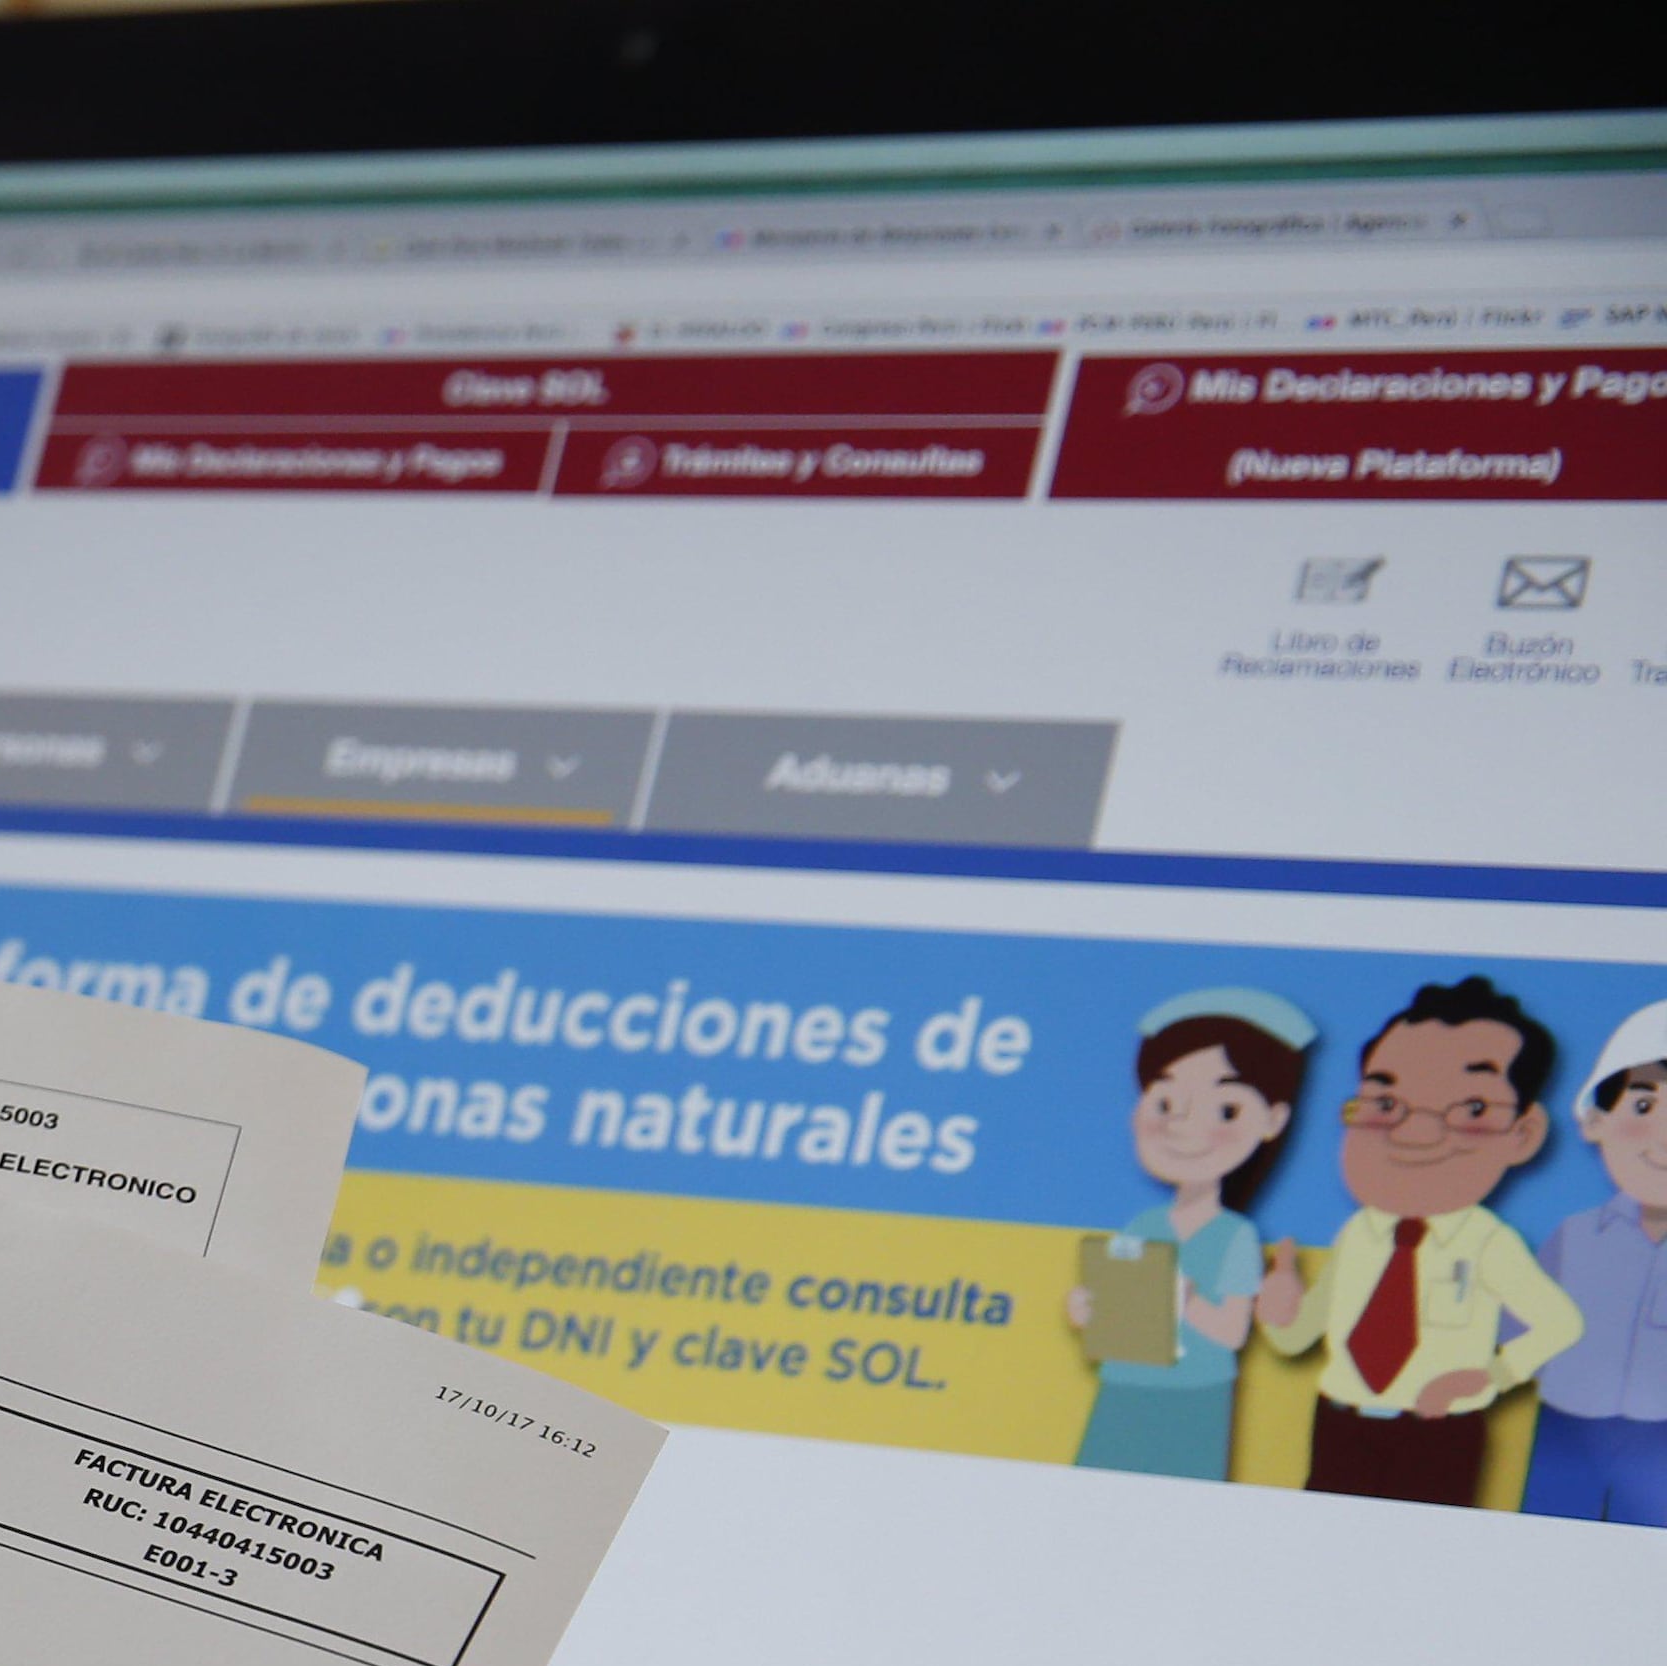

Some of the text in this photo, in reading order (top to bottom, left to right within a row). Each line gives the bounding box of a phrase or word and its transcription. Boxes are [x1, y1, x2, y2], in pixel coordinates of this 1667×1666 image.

[1187, 367, 1566, 405] Mis Declaraciones y
[1225, 449, 1562, 486] (Nueva Plataforma)
[1447, 659, 1601, 685] Electrónico
[1483, 630, 1575, 657] Buzón
[767, 753, 953, 798] Aduanas
[231, 956, 1033, 1076] de deducciones de
[571, 1086, 978, 1174] naturales
[367, 1231, 1013, 1328] o independiente consulta
[518, 1311, 615, 1358] DNI
[625, 1331, 659, 1371] y
[673, 1326, 807, 1376] clave
[823, 1340, 947, 1390] SOL.
[435, 1385, 597, 1459] 17/10/17 16:12
[73, 1449, 386, 1561] FACTURA ELECTRONICA
[82, 1489, 336, 1581] RUC: 10440415003
[142, 1544, 239, 1588] E001-3
